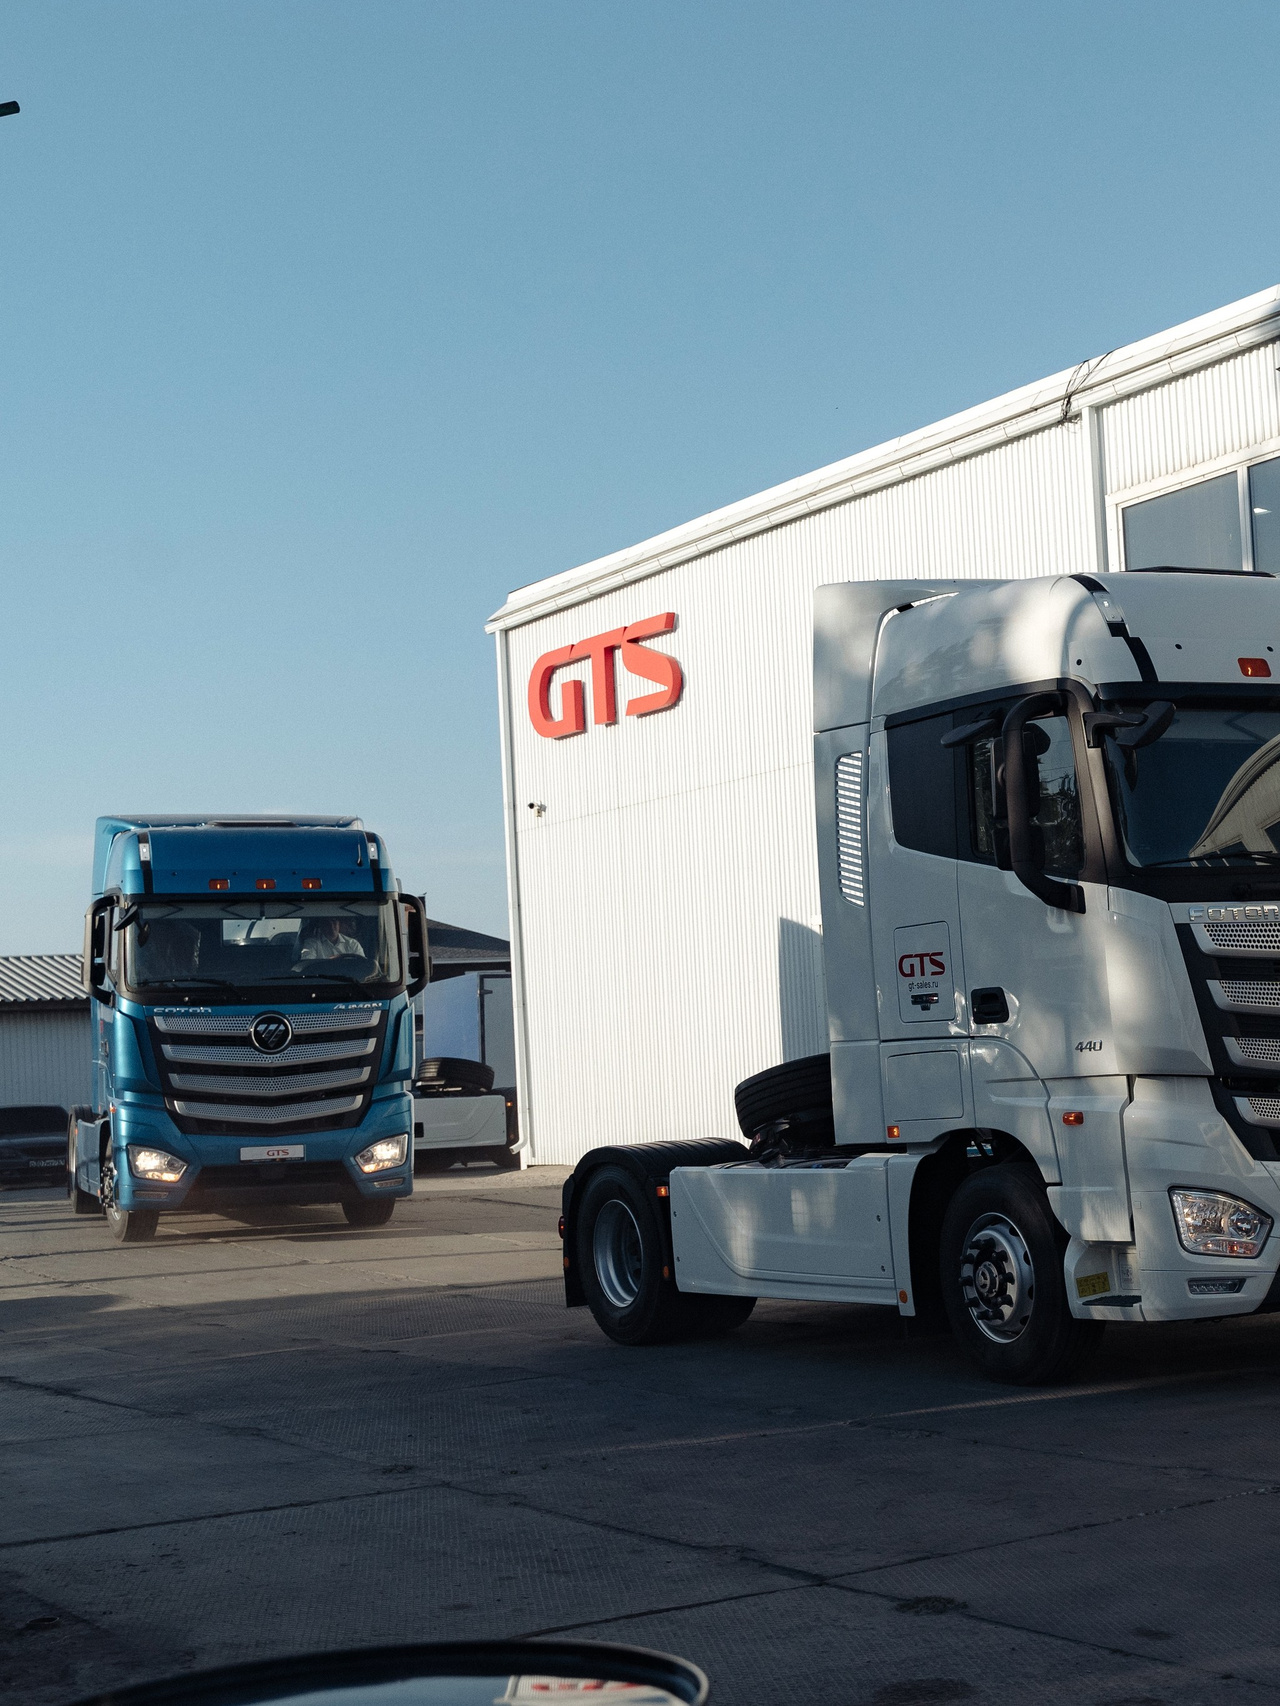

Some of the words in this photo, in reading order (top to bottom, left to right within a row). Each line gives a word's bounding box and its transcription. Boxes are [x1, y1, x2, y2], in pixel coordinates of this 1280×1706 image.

[527, 612, 683, 738] GTS
[1189, 905, 1280, 922] FOTON
[898, 951, 946, 978] GTS
[907, 980, 939, 993] gt-sales.ru
[1074, 1039, 1103, 1053] 440
[266, 1148, 290, 1157] GTS
